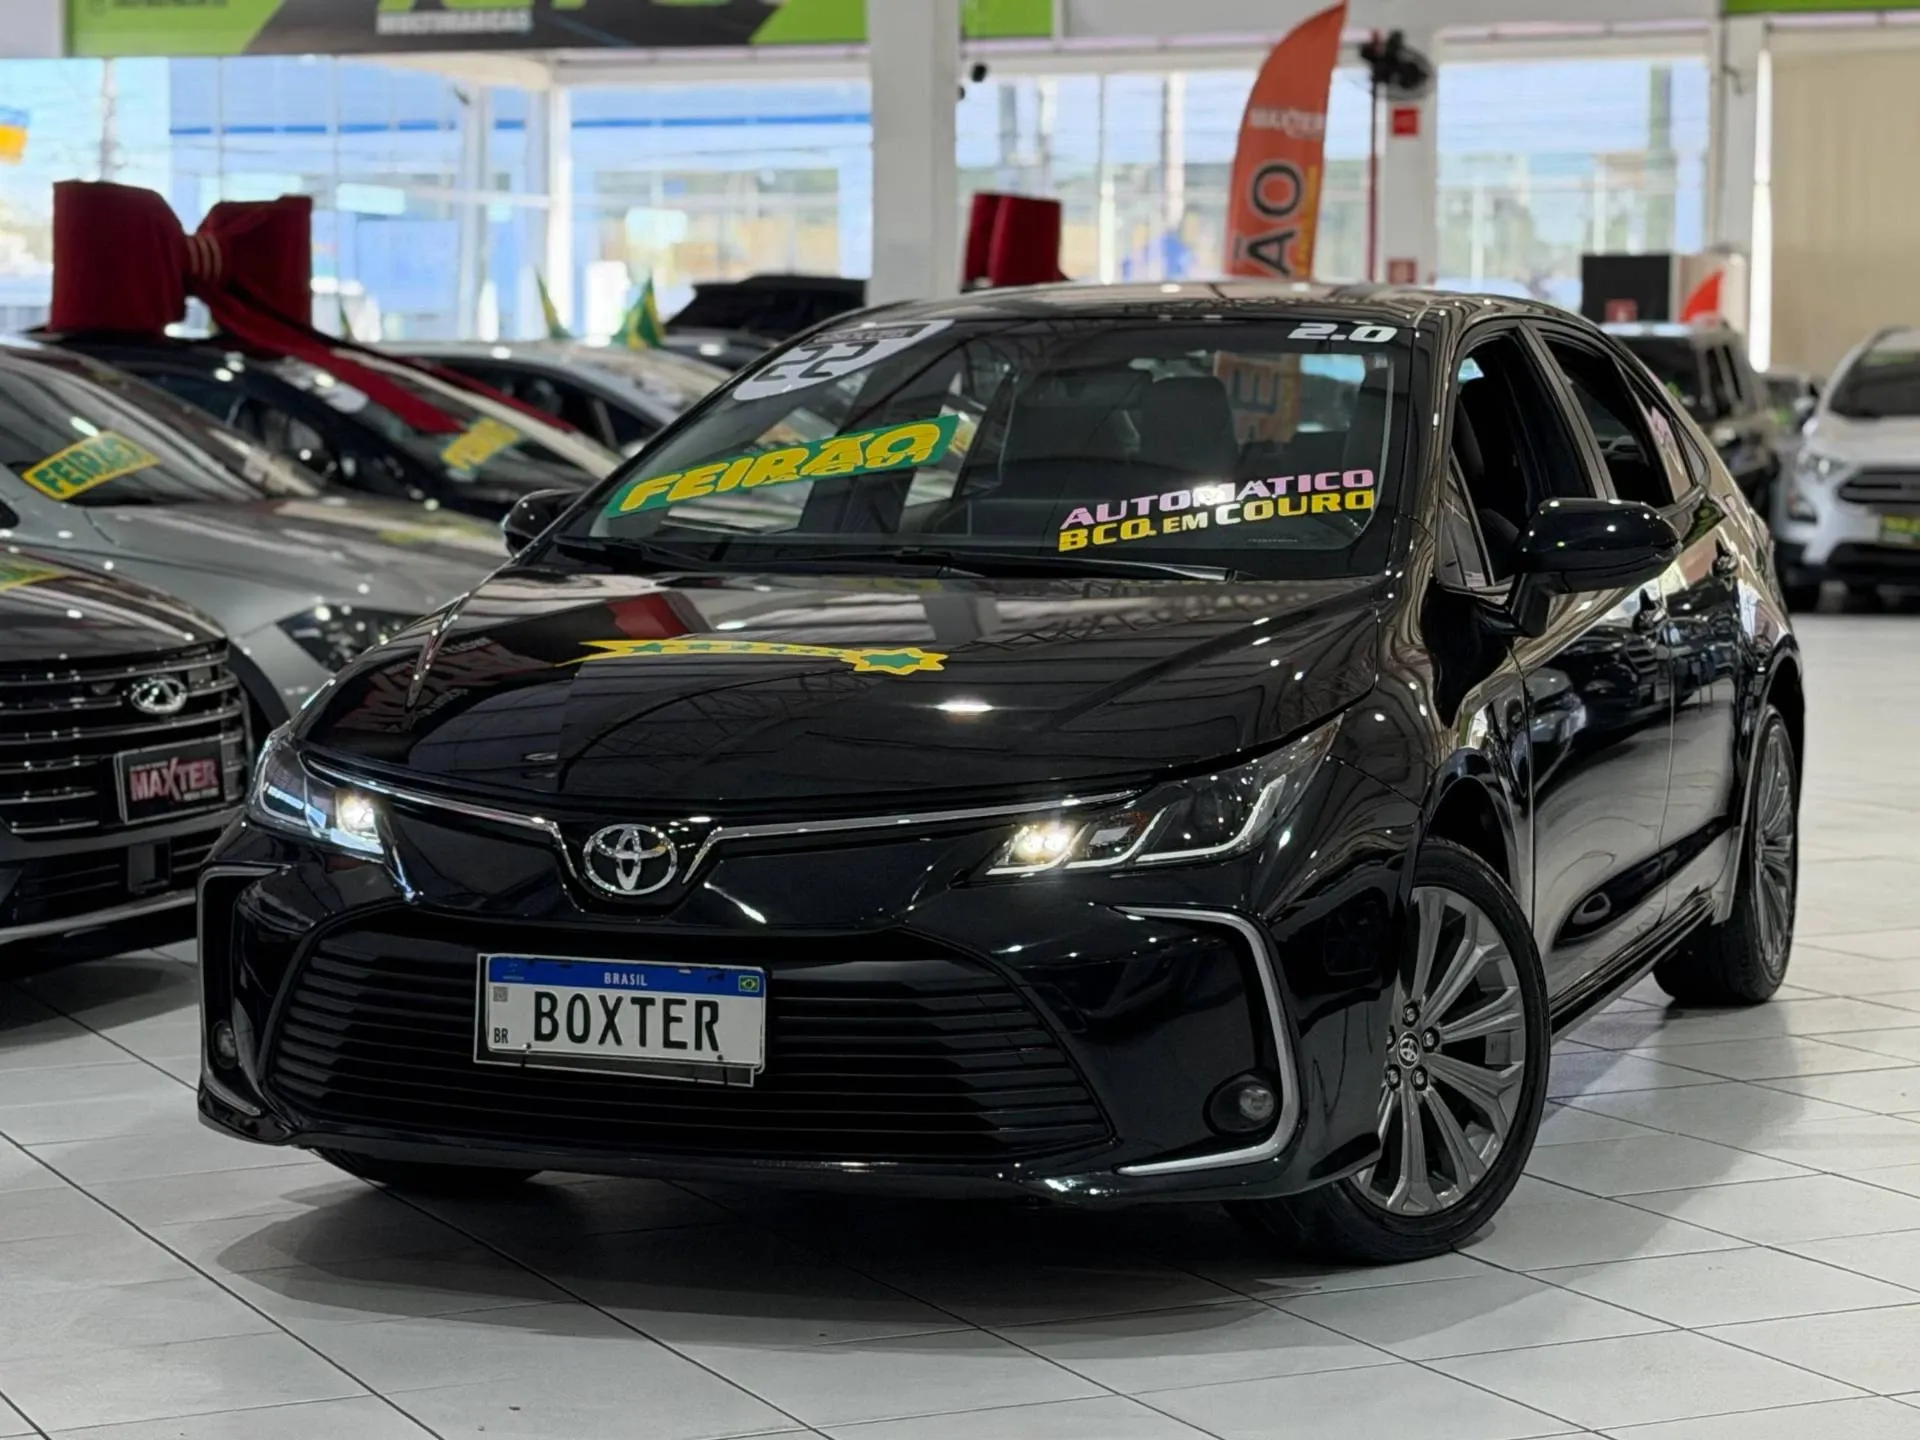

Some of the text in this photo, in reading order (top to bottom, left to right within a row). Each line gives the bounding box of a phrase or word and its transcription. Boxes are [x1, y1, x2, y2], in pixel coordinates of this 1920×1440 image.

[1287, 322, 1398, 343] 2.0
[619, 423, 940, 512] FEIRÃO
[1163, 511, 1208, 534] EM
[1215, 489, 1375, 526] COURO
[130, 757, 219, 801] MAXTER
[603, 971, 648, 987] BRASIL
[493, 1027, 509, 1044] BR
[534, 991, 720, 1052] BOXTER
